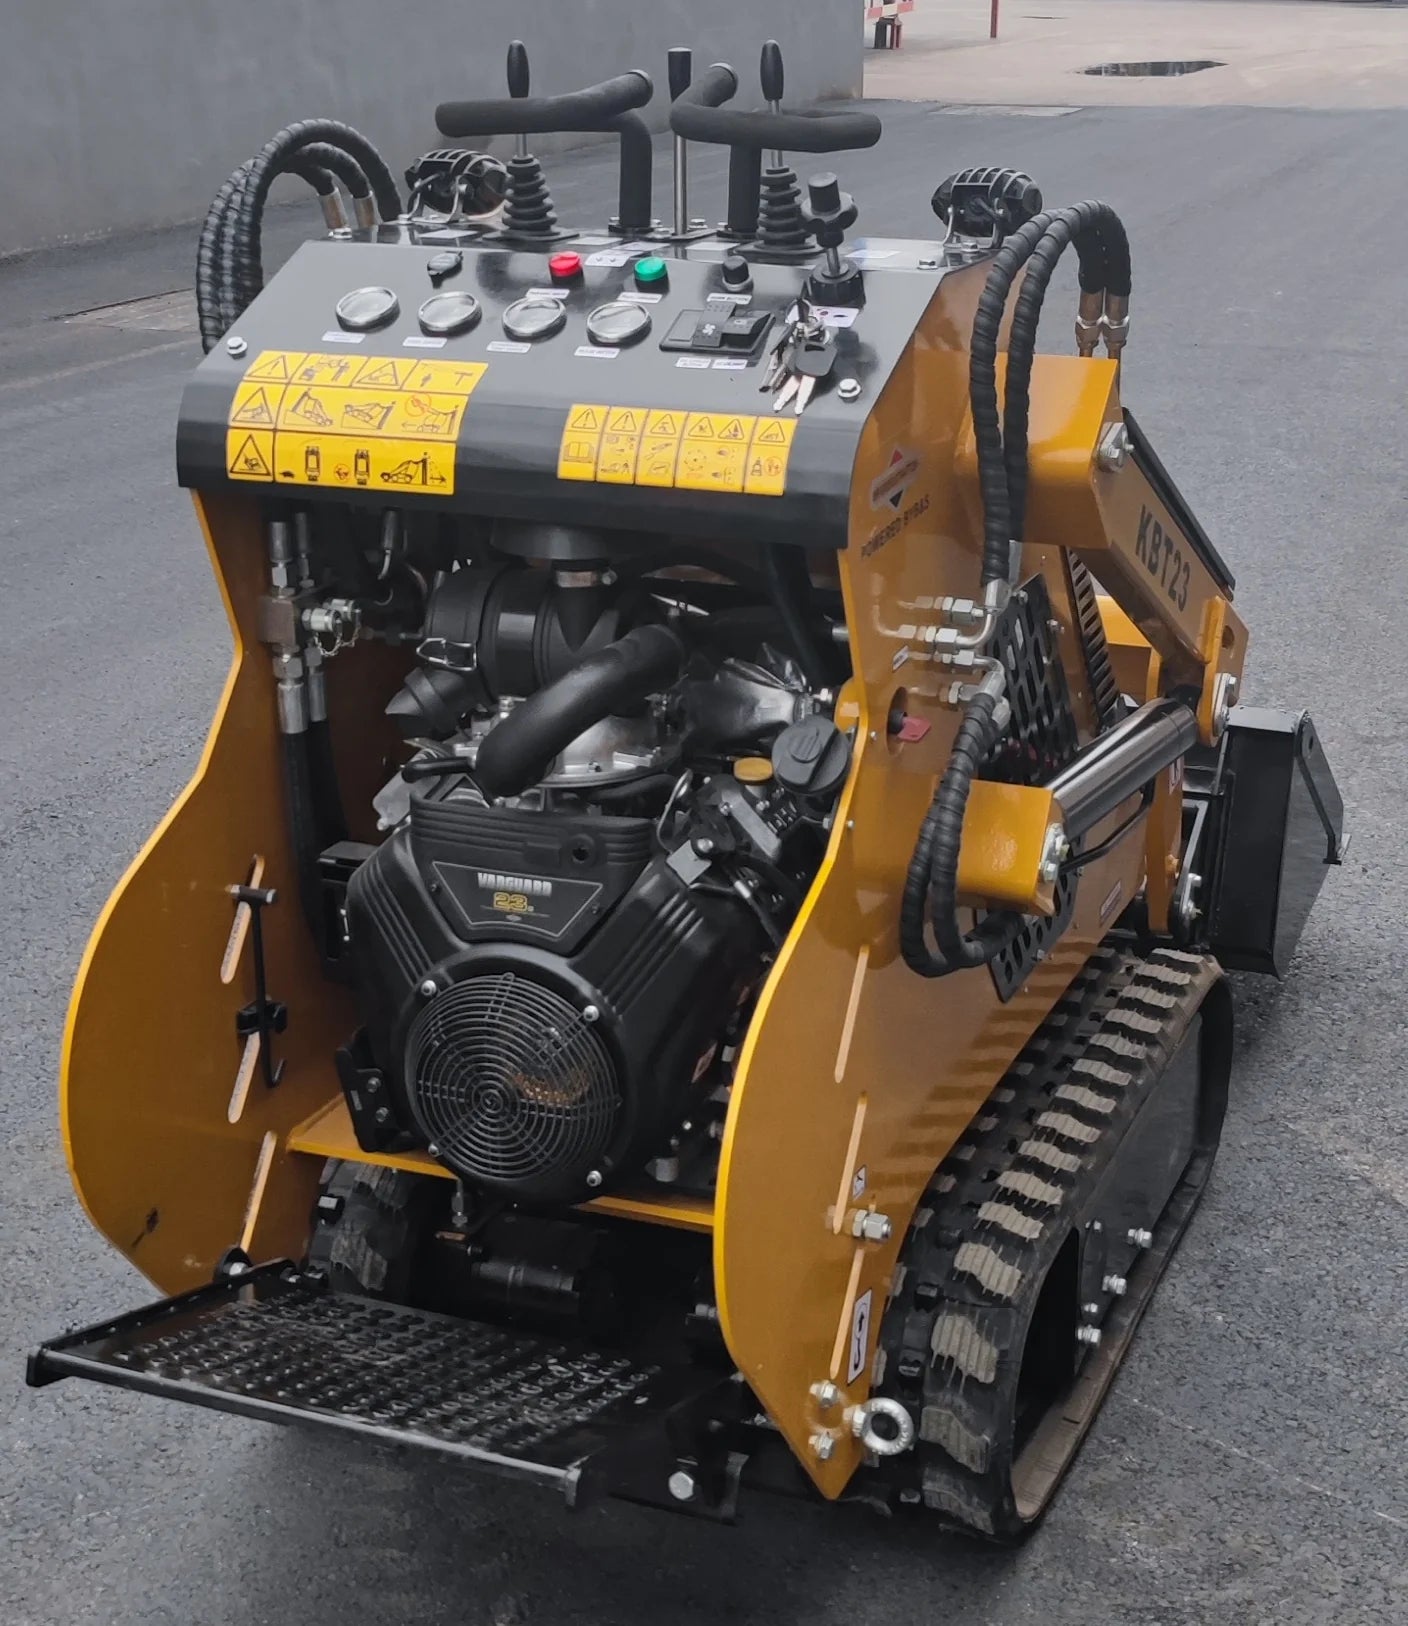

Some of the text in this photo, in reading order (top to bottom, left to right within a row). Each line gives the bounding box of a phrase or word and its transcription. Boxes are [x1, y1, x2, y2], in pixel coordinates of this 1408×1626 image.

[861, 517, 902, 557] POWERED
[1135, 503, 1190, 612] KBT23
[477, 872, 553, 897] VANGUARD
[494, 892, 528, 912] 23
